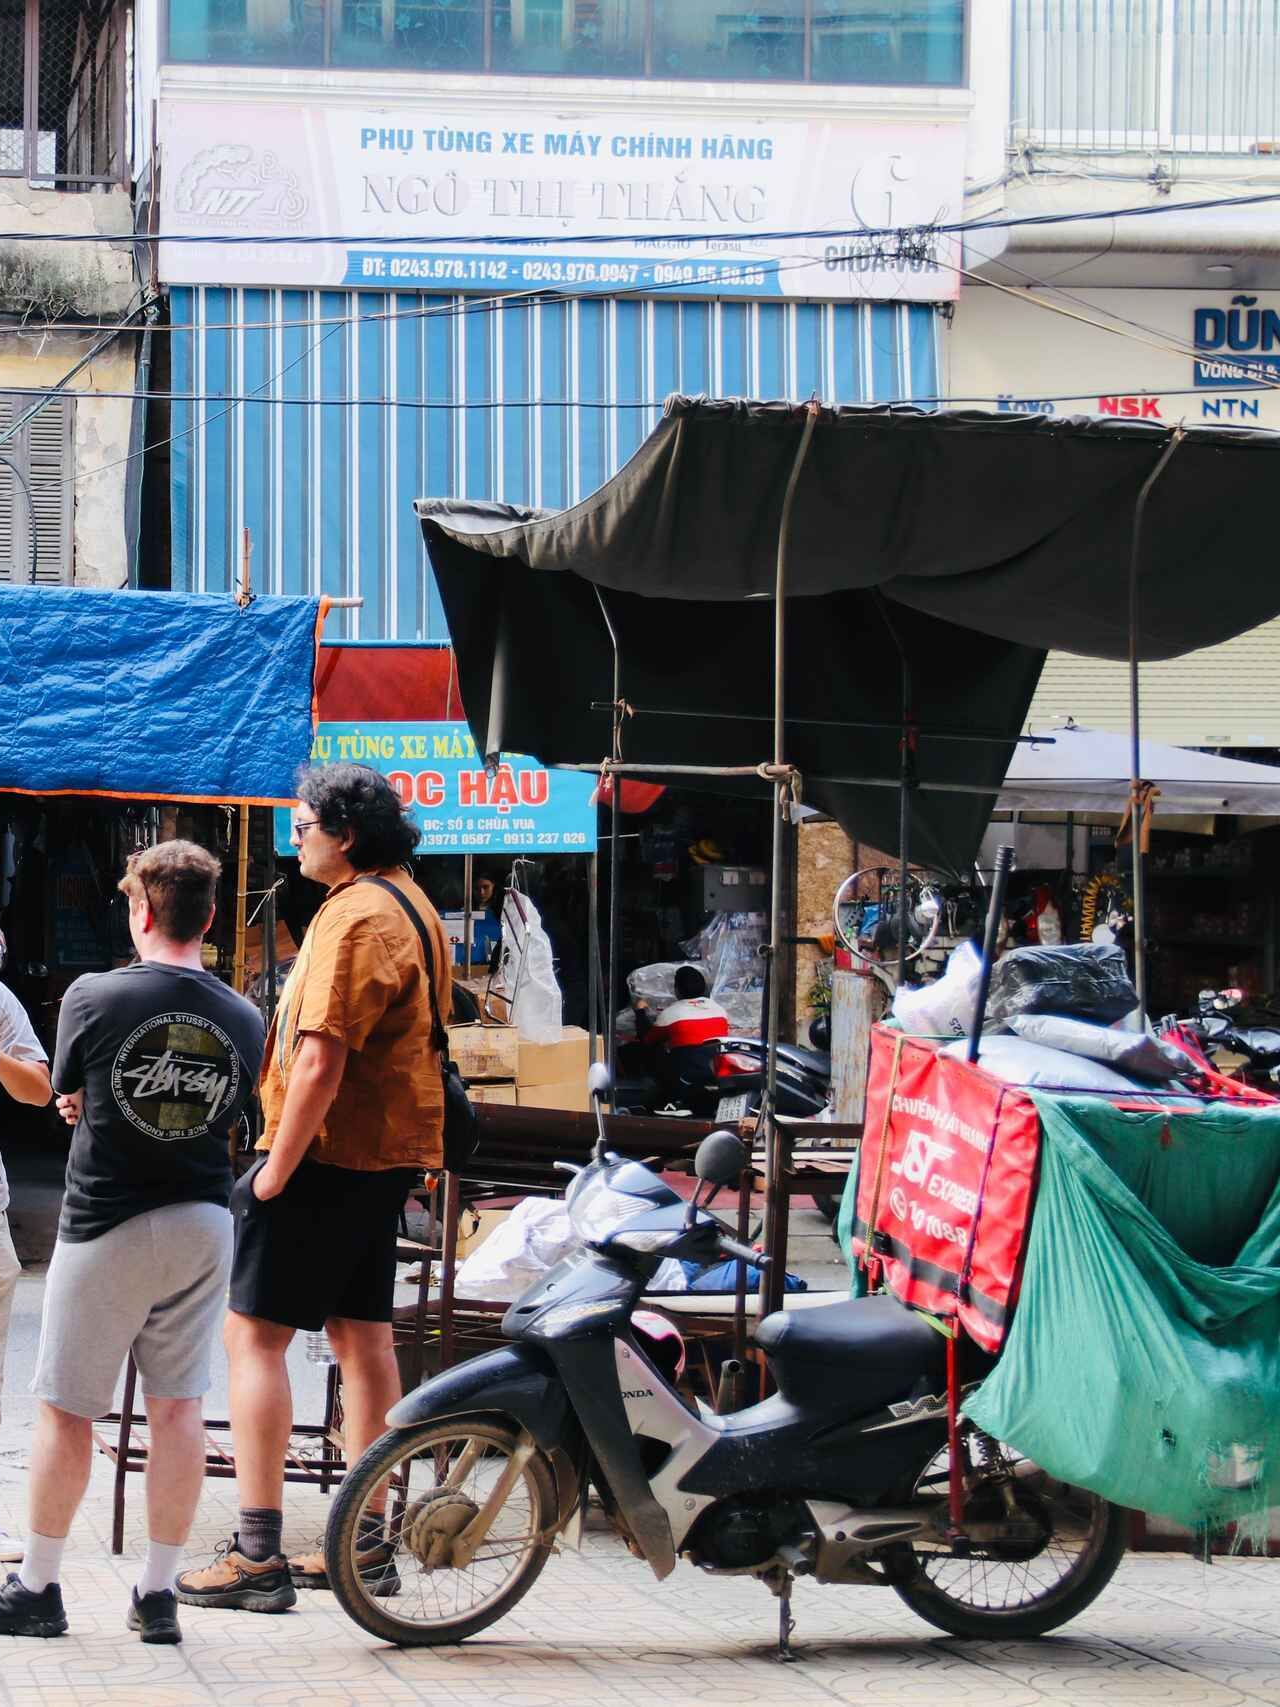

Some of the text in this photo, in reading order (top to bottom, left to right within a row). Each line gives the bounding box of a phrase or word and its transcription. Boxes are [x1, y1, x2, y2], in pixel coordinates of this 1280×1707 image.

[361, 128, 414, 155] PHỤ
[422, 126, 493, 153] TÙNG
[502, 132, 535, 154] XE
[544, 131, 602, 157] MÁY
[611, 132, 692, 159] CHÍNH
[390, 257, 508, 280] 0243.978.1142
[1098, 396, 1162, 418] NSK
[1202, 399, 1259, 417] NTN
[337, 729, 395, 759] TÙNG
[400, 735, 428, 759] XE
[458, 763, 549, 814] HẬU
[537, 833, 562, 845] 237
[119, 1016, 173, 1063] INTERNATIONAL
[175, 1015, 209, 1029] STUSSY
[209, 1025, 230, 1048] TRIBE
[113, 1067, 122, 1088] KING
[119, 1097, 164, 1137] KNOWLEDGE
